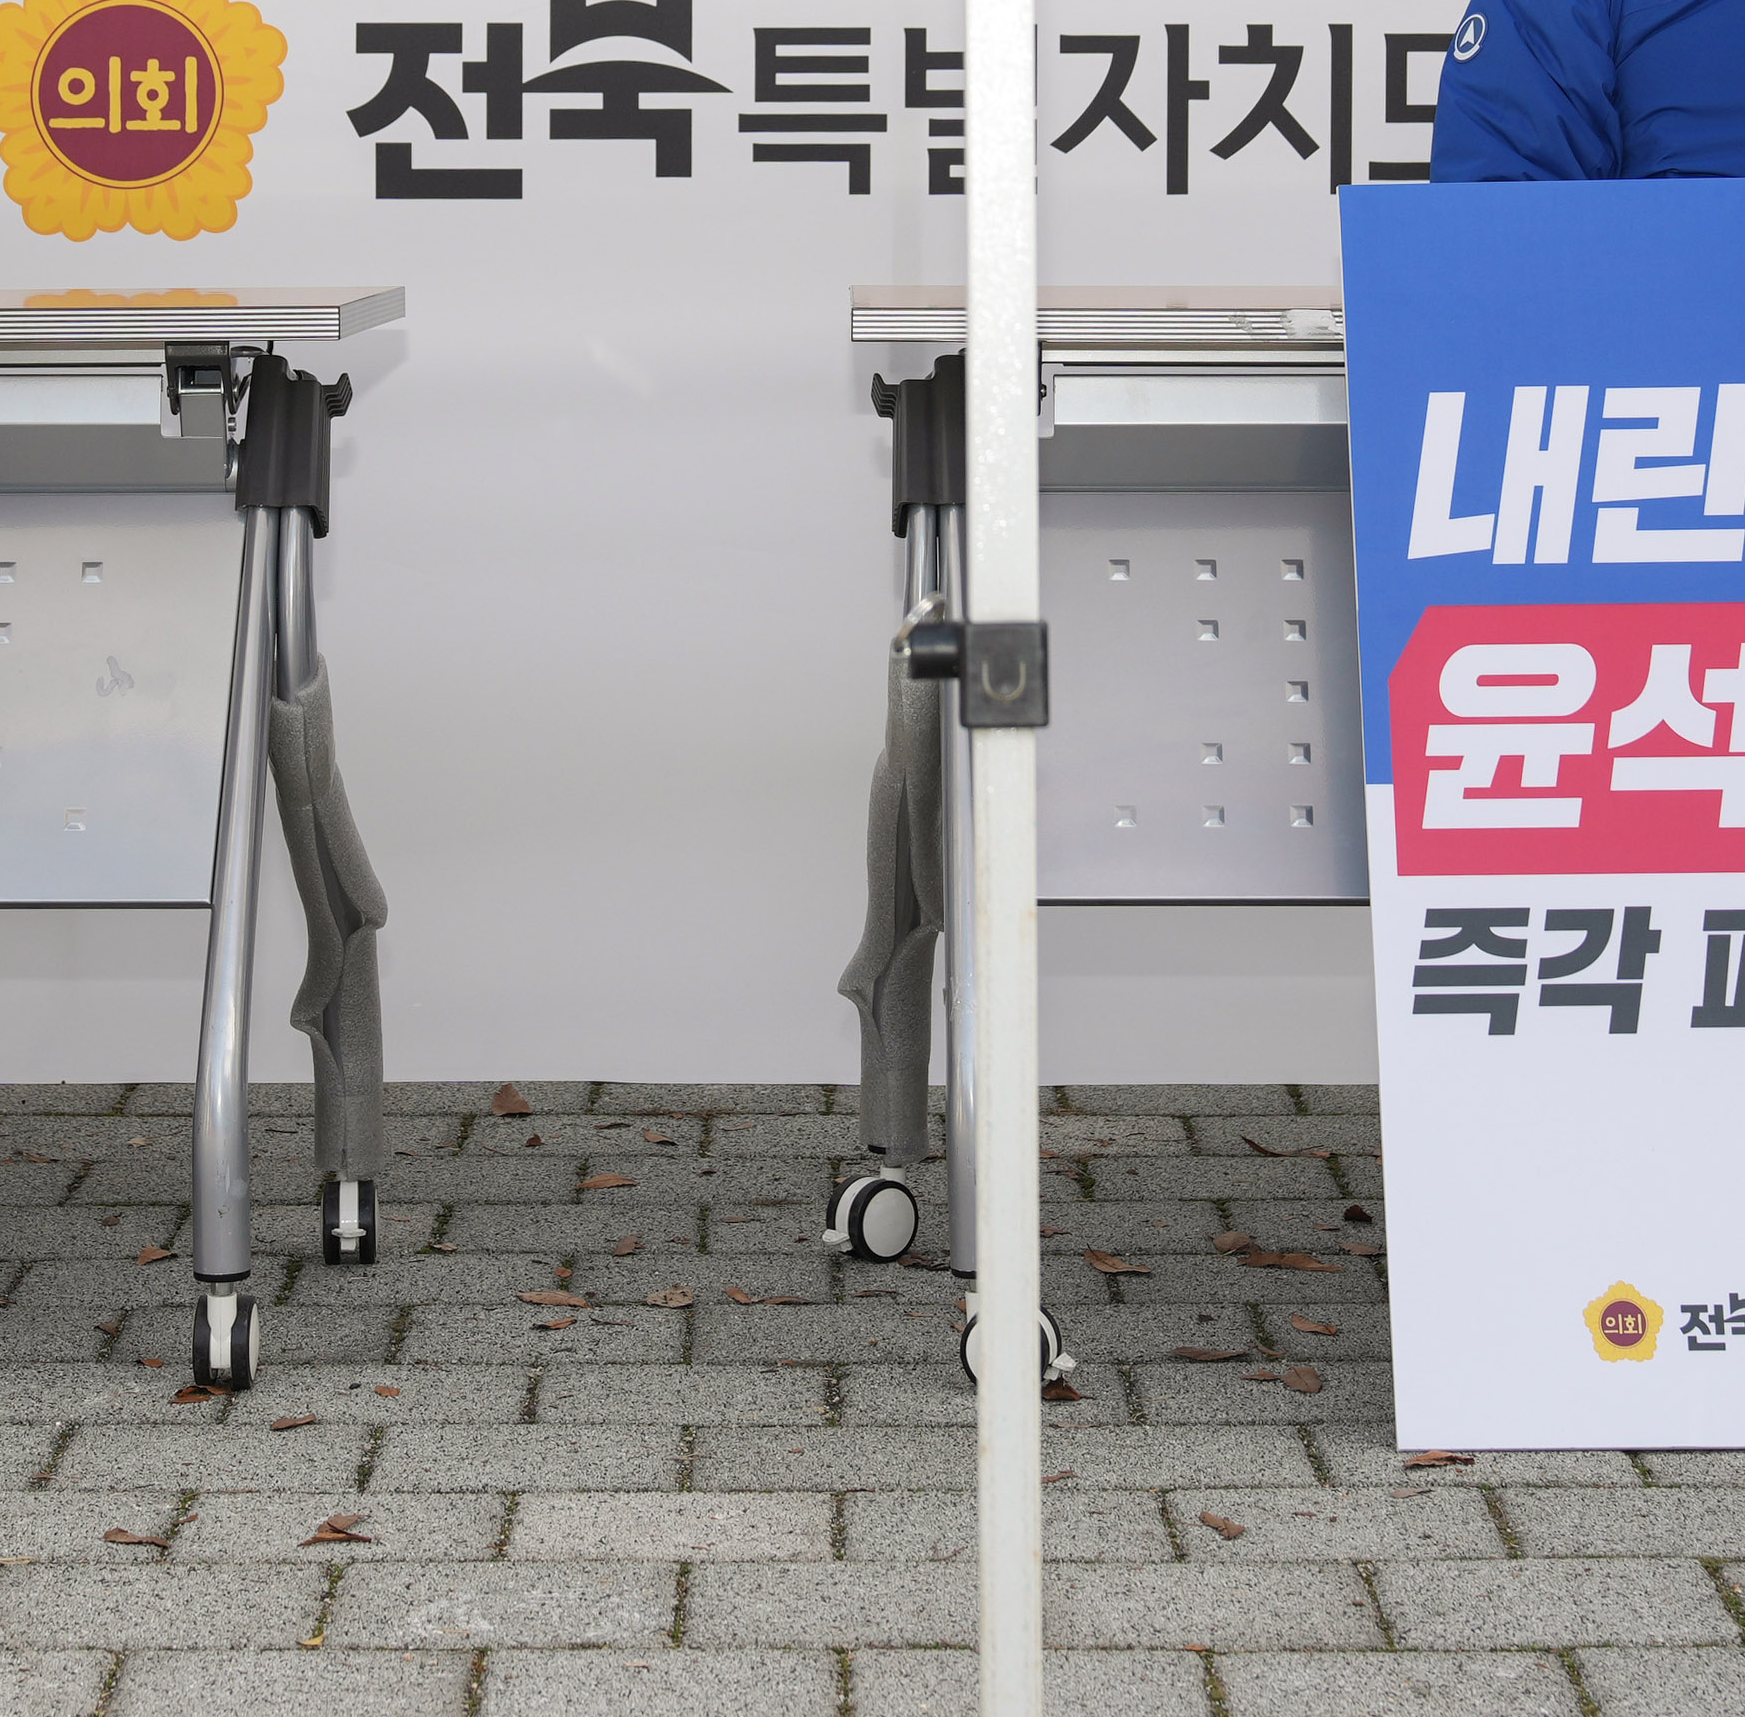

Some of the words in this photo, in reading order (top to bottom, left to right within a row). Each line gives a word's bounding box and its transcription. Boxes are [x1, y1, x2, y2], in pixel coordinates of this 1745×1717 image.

[46, 63, 199, 135] 의회
[1412, 906, 1661, 1036] 즉각
[1604, 1313, 1643, 1337] 의회
